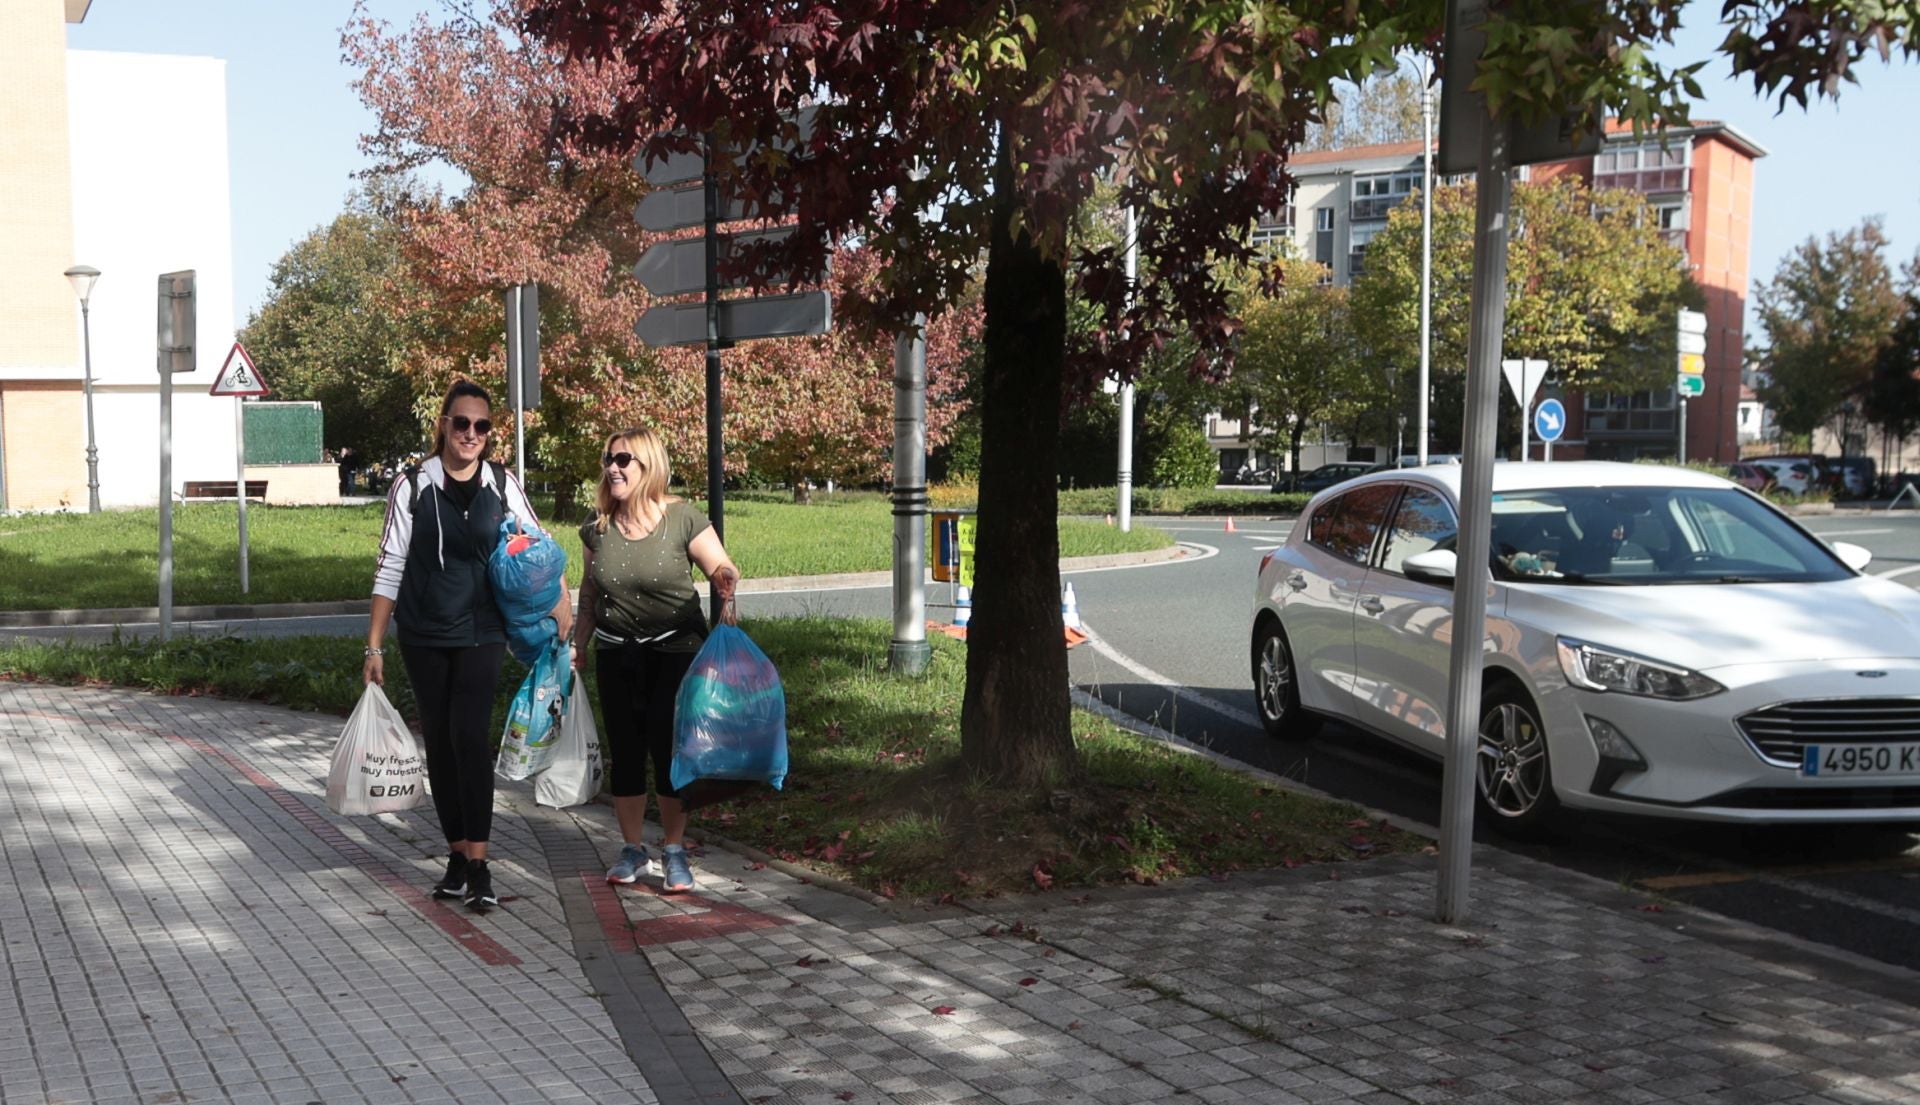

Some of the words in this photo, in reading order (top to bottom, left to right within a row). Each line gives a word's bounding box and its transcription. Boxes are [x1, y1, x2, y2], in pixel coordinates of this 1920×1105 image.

[366, 753, 385, 765] Muy
[1824, 747, 1890, 771] 4950
[1900, 746, 1920, 771] K
[361, 766, 382, 777] muy
[388, 784, 415, 796] BM
